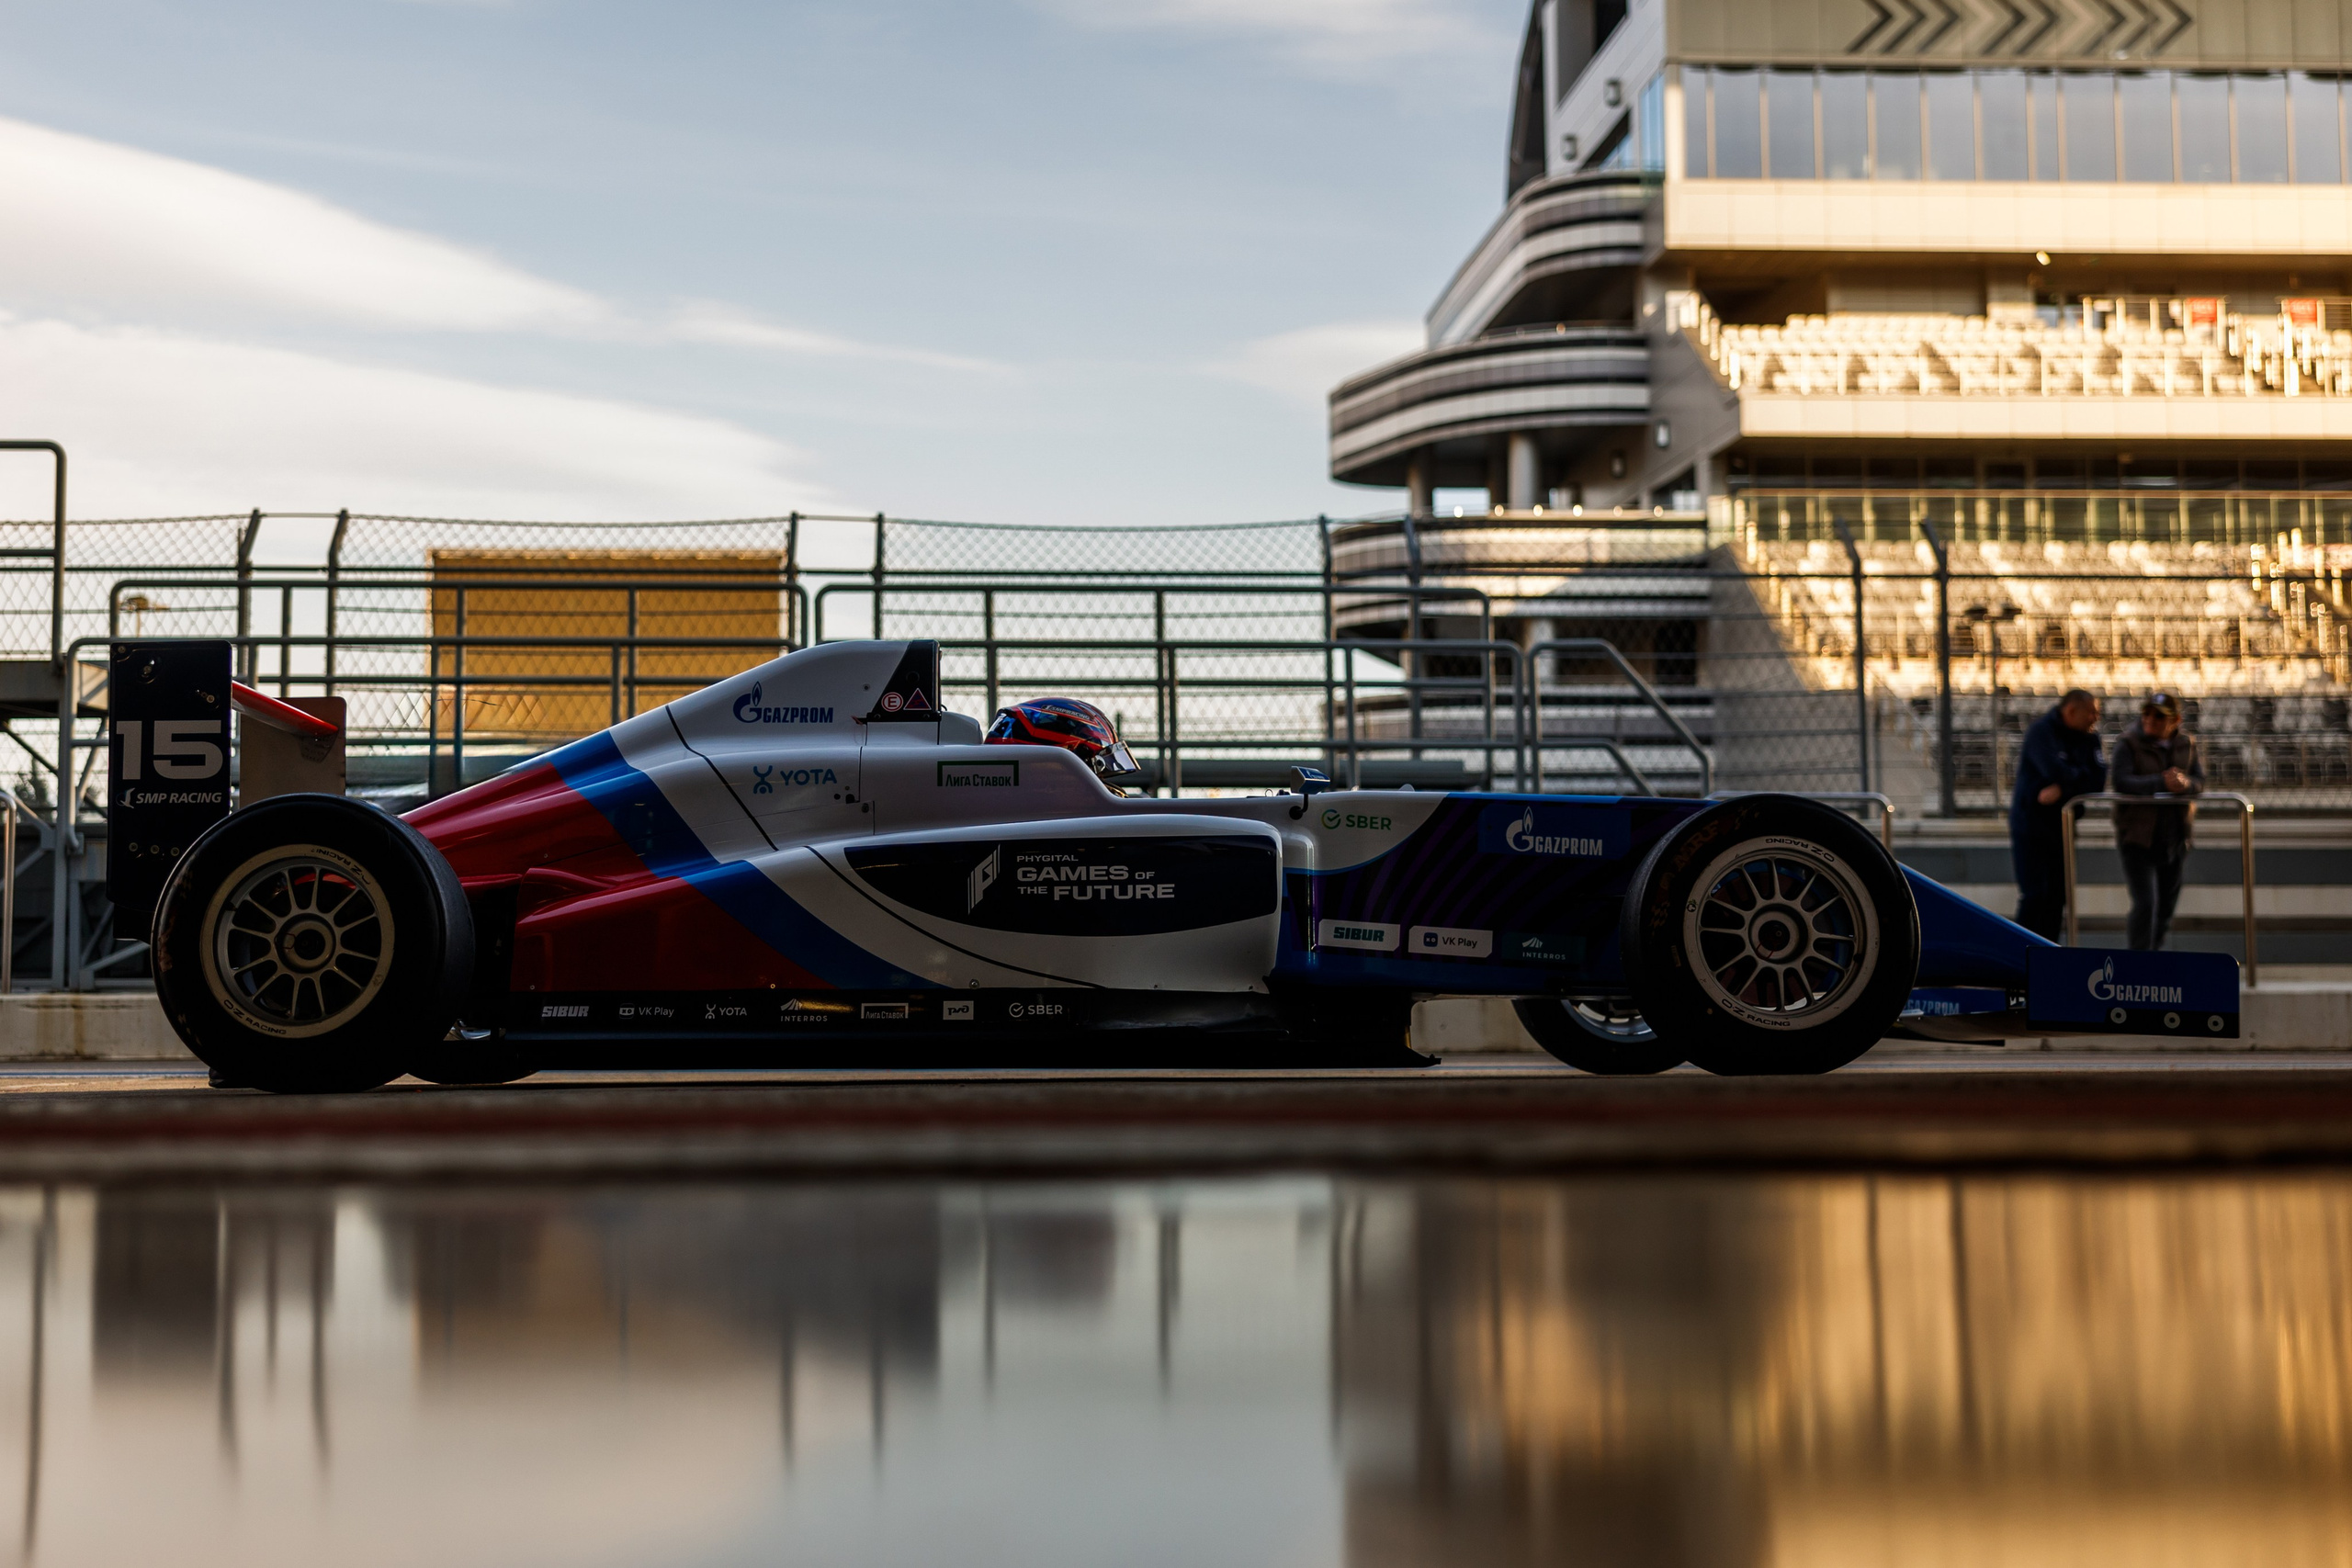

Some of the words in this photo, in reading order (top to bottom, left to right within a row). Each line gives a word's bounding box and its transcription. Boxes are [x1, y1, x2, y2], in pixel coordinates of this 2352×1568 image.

[763, 706, 834, 724] GAZPROM
[116, 719, 223, 780] 15
[780, 768, 838, 786] YOTA
[136, 793, 167, 804] SMP
[169, 792, 222, 804] RACING
[1345, 814, 1392, 830] SBER
[1534, 836, 1603, 856] GAZPROM
[1765, 838, 1809, 850] RACING
[1016, 854, 1079, 863] PHYGITAL
[1016, 865, 1129, 882] GAMES
[1135, 871, 1156, 880] OF
[1017, 886, 1048, 895] THE
[1053, 884, 1175, 901] FUTURE
[1333, 926, 1385, 942] SIBUR
[1442, 936, 1457, 946] VK
[1458, 937, 1478, 949] Play
[1521, 952, 1566, 961] INTERROS
[2116, 984, 2183, 1004] GAZPROM
[541, 1005, 590, 1017] SIBUR
[639, 1007, 653, 1016] VK
[654, 1007, 675, 1019] Play
[718, 1007, 748, 1017] YOTA
[1027, 1004, 1063, 1015] SBER
[245, 1017, 287, 1035] RACING
[1747, 1013, 1791, 1027] RACING
